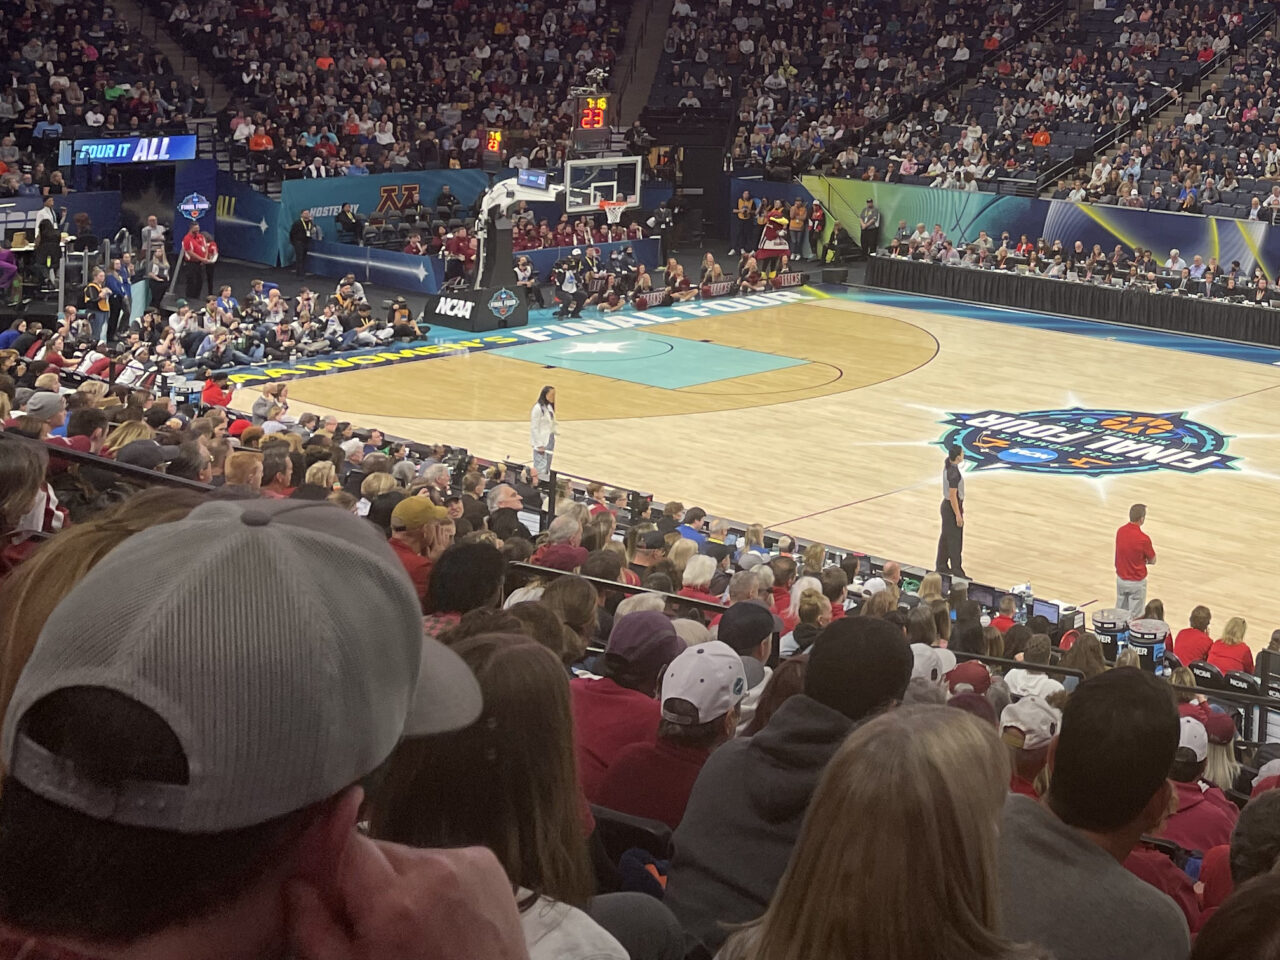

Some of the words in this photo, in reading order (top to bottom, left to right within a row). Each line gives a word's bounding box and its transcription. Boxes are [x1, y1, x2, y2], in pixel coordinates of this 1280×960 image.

[581, 109, 604, 129] 23
[116, 143, 131, 157] IT
[131, 137, 170, 162] ALL
[435, 296, 474, 320] NCAA
[511, 311, 682, 342] FINAL
[966, 414, 1094, 444] FOUR
[1093, 436, 1222, 469] FINAL
